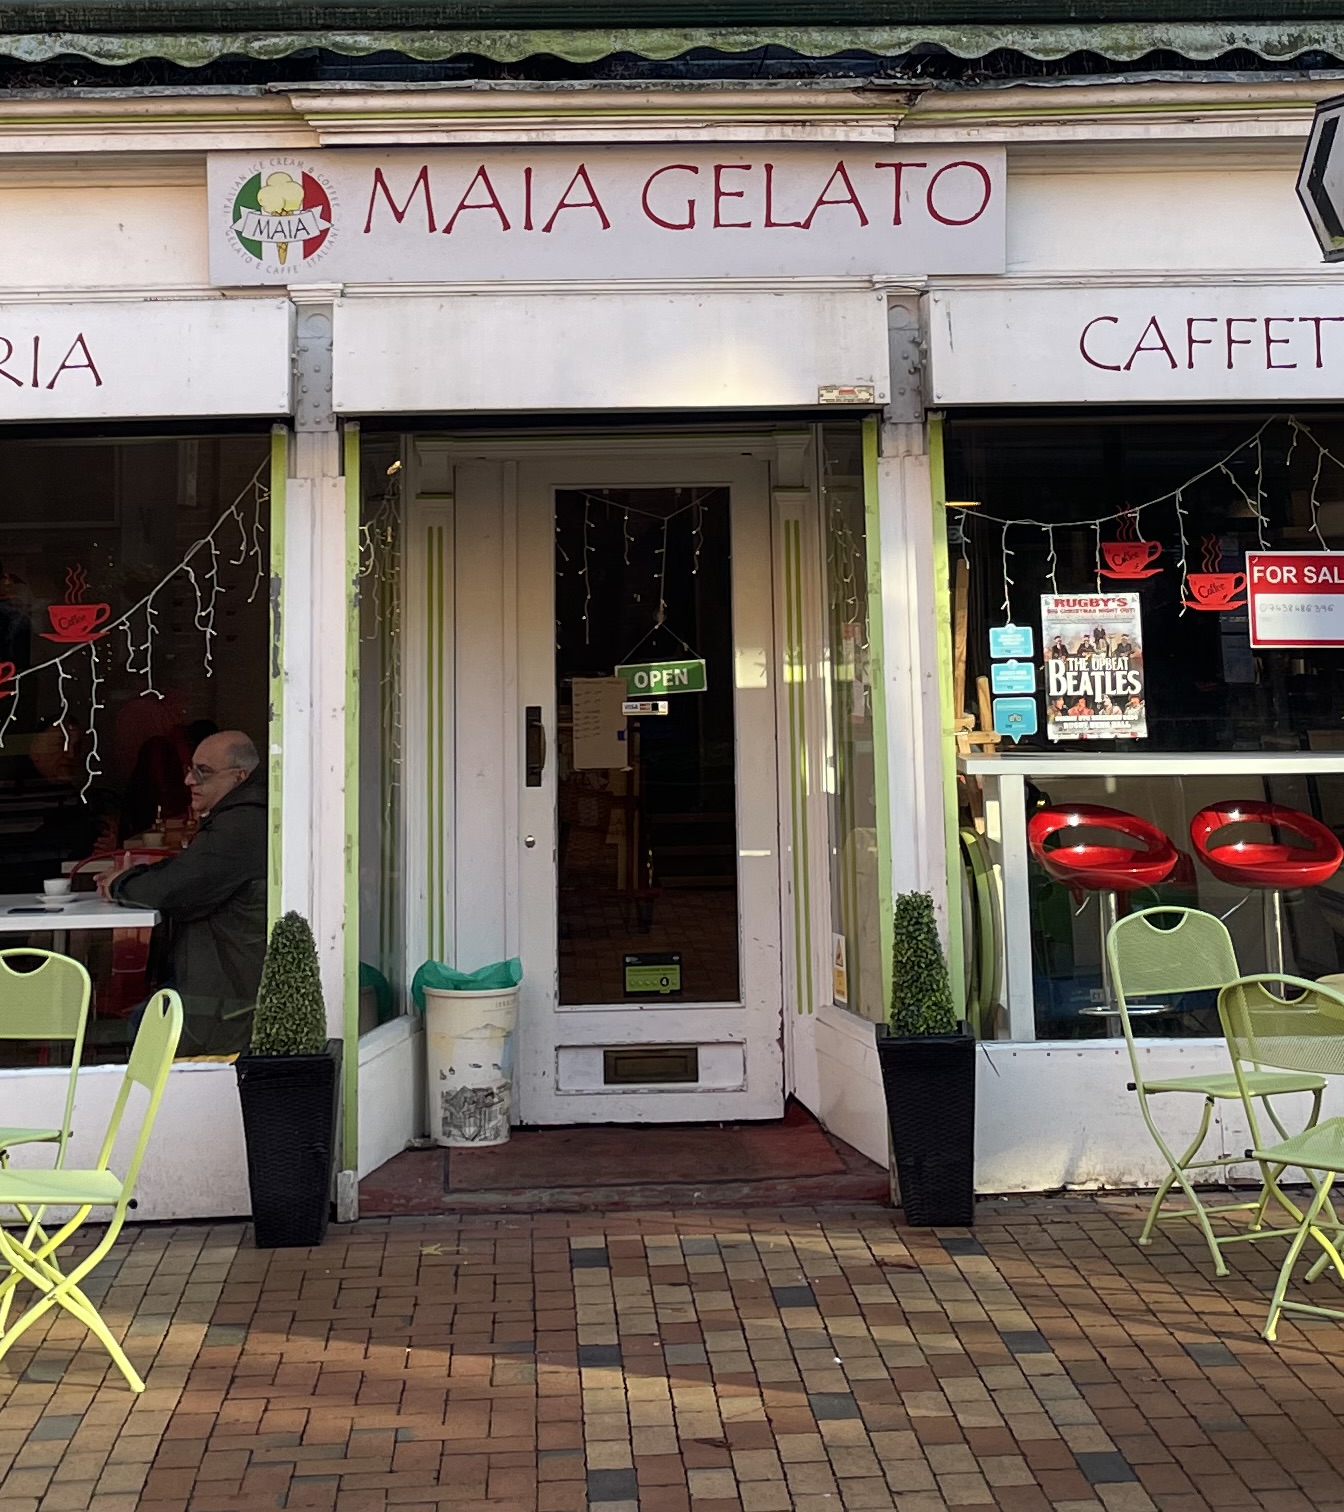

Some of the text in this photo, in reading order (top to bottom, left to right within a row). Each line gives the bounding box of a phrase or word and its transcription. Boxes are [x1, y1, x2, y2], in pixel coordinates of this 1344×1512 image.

[224, 175, 247, 214] ITALIAN
[249, 161, 266, 173] ICE
[269, 157, 304, 168] CREAM
[317, 173, 341, 208] COFFEE
[363, 159, 992, 234] MAIA GELATO
[252, 218, 310, 240] MAIA
[225, 229, 253, 264] GELATO
[1112, 552, 1140, 566] Coffee
[1253, 566, 1298, 584] FOR
[1198, 583, 1225, 598] Coffee
[1053, 598, 1128, 607] RUGBY'S
[58, 614, 86, 630] Coffee
[1067, 657, 1129, 671] THE UPBEAT
[634, 668, 688, 688] OPEN
[1049, 659, 1142, 703] BEATLES
